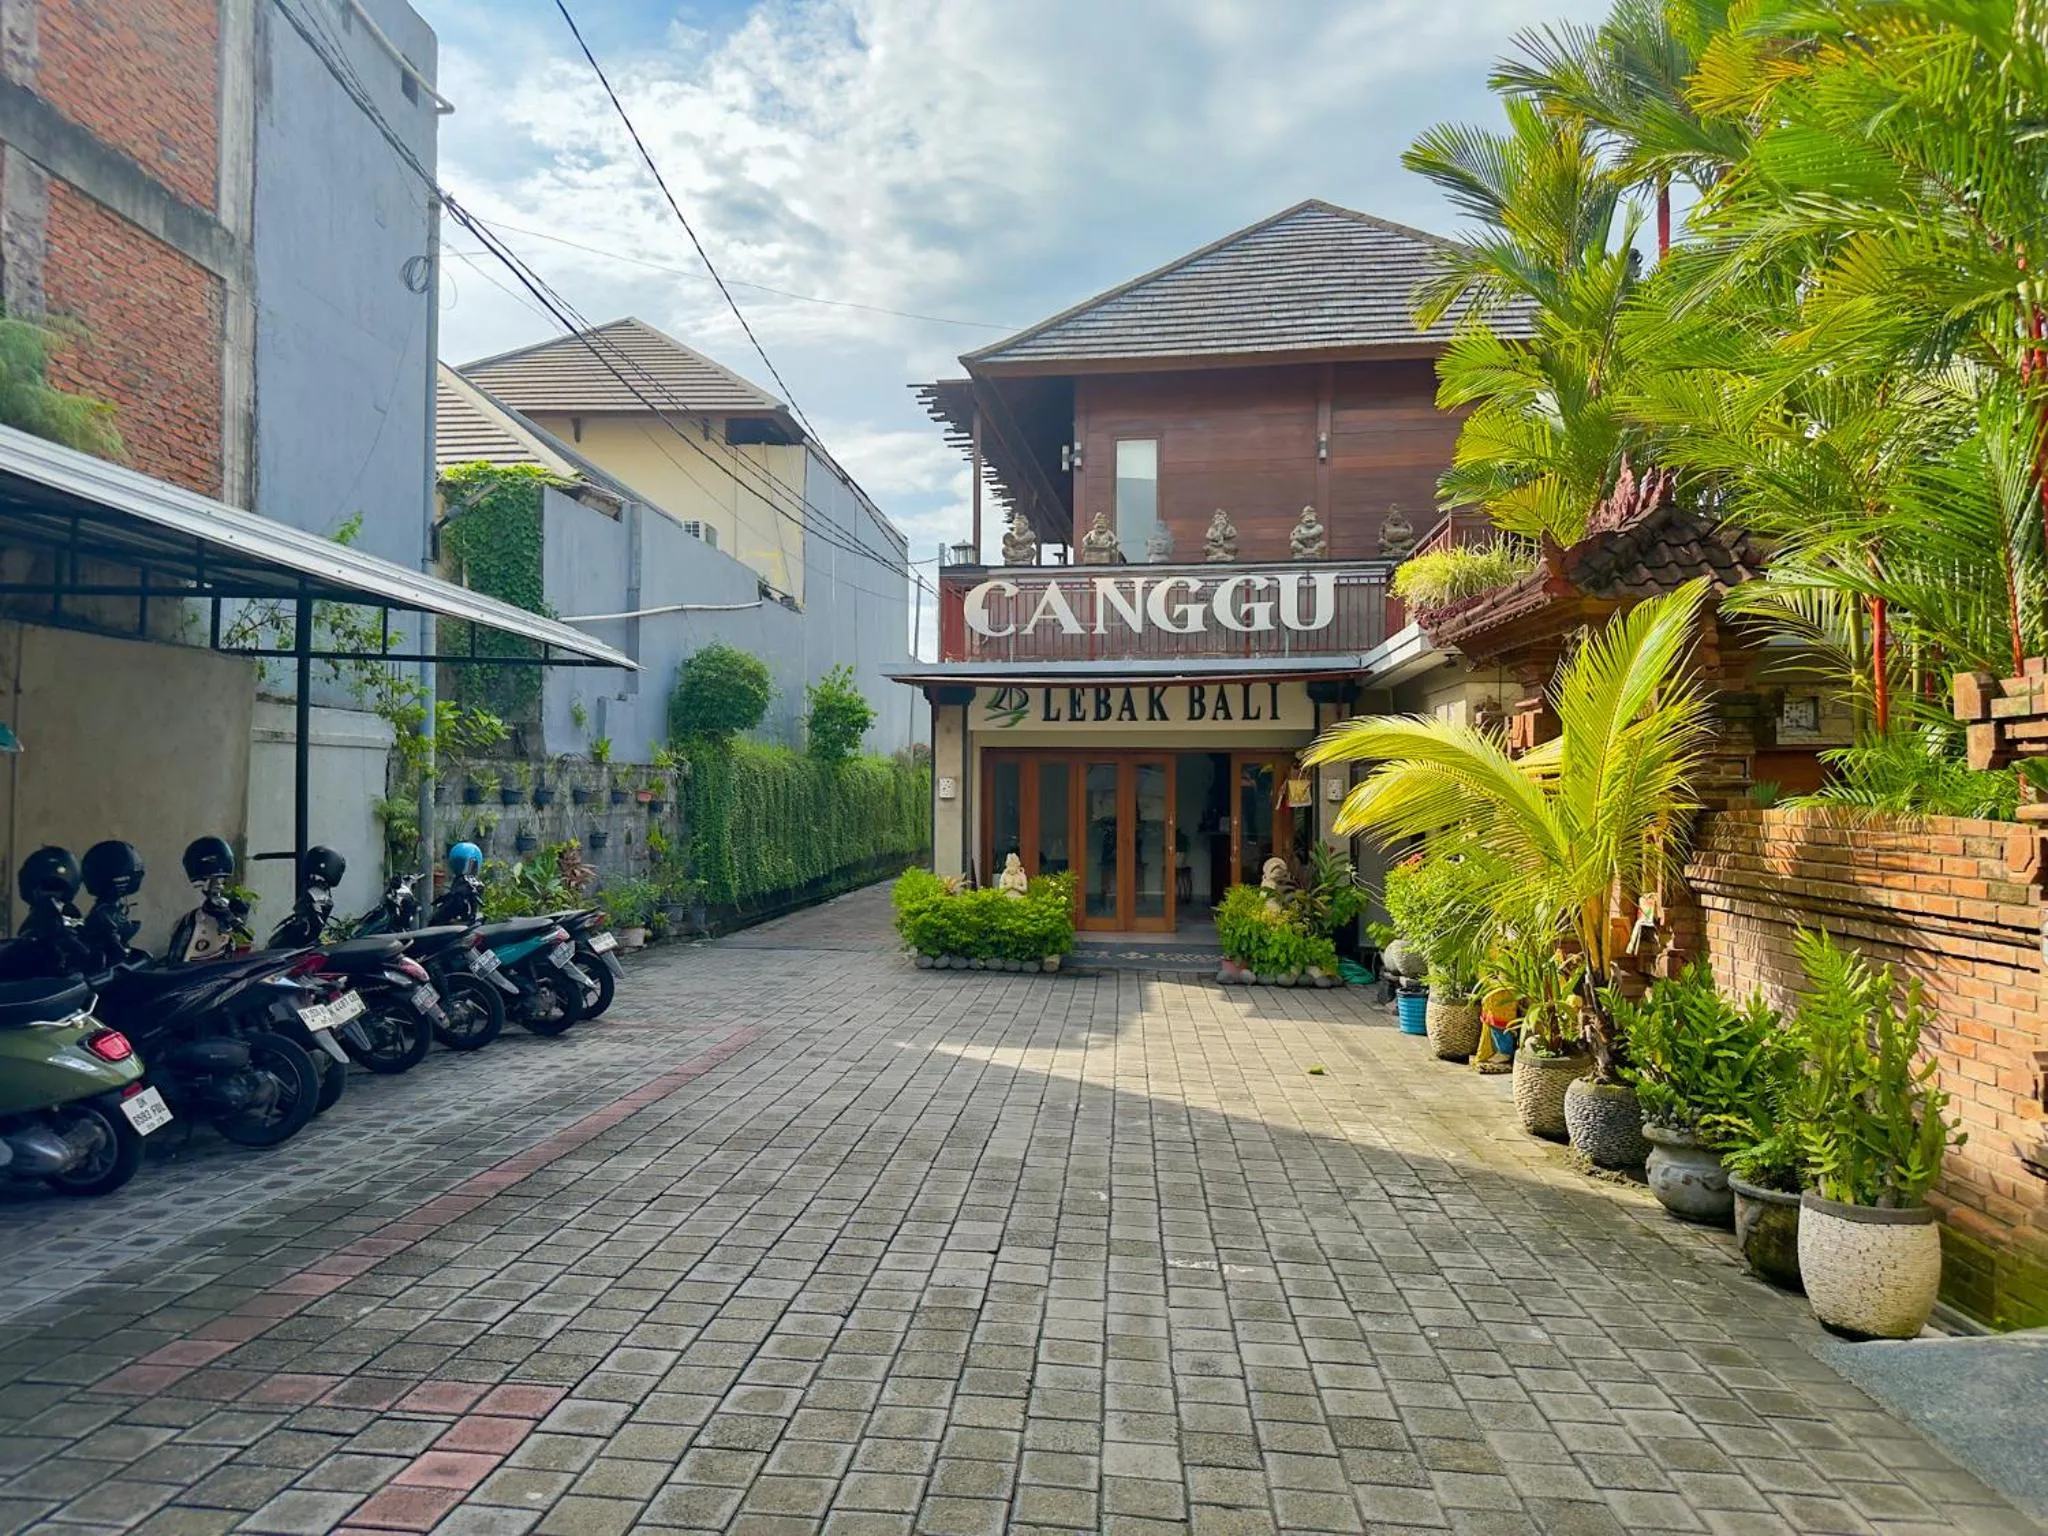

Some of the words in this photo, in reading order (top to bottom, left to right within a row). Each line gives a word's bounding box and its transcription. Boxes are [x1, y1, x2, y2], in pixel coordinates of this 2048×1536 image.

[963, 574, 1338, 637] CANGGU
[1042, 686, 1170, 721] LEBAK
[1186, 682, 1281, 721] BALI
